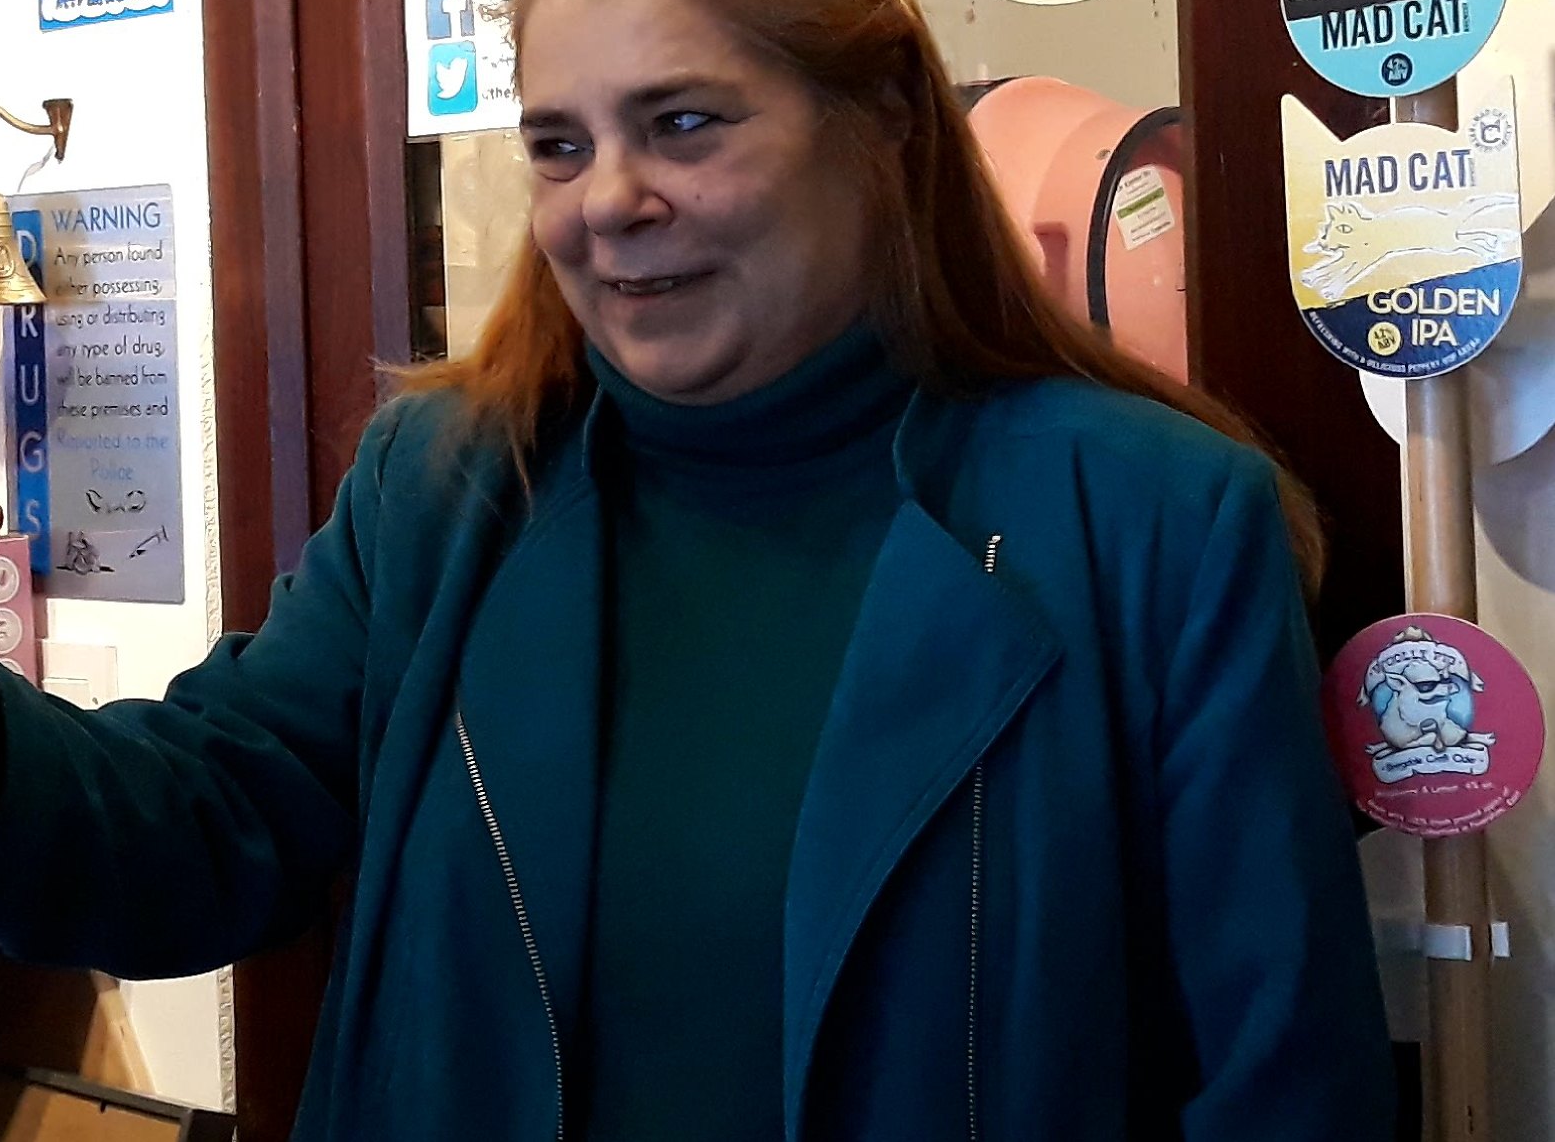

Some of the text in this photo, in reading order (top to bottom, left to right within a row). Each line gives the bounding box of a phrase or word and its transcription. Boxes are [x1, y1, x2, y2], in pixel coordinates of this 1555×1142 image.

[1320, 3, 1392, 51] MAD
[1324, 156, 1397, 198] MAD
[1408, 149, 1471, 191] CAT
[52, 202, 162, 233] WARNING
[83, 251, 124, 266] person
[1367, 288, 1501, 316] GOLDEN
[1411, 319, 1460, 346] IPA
